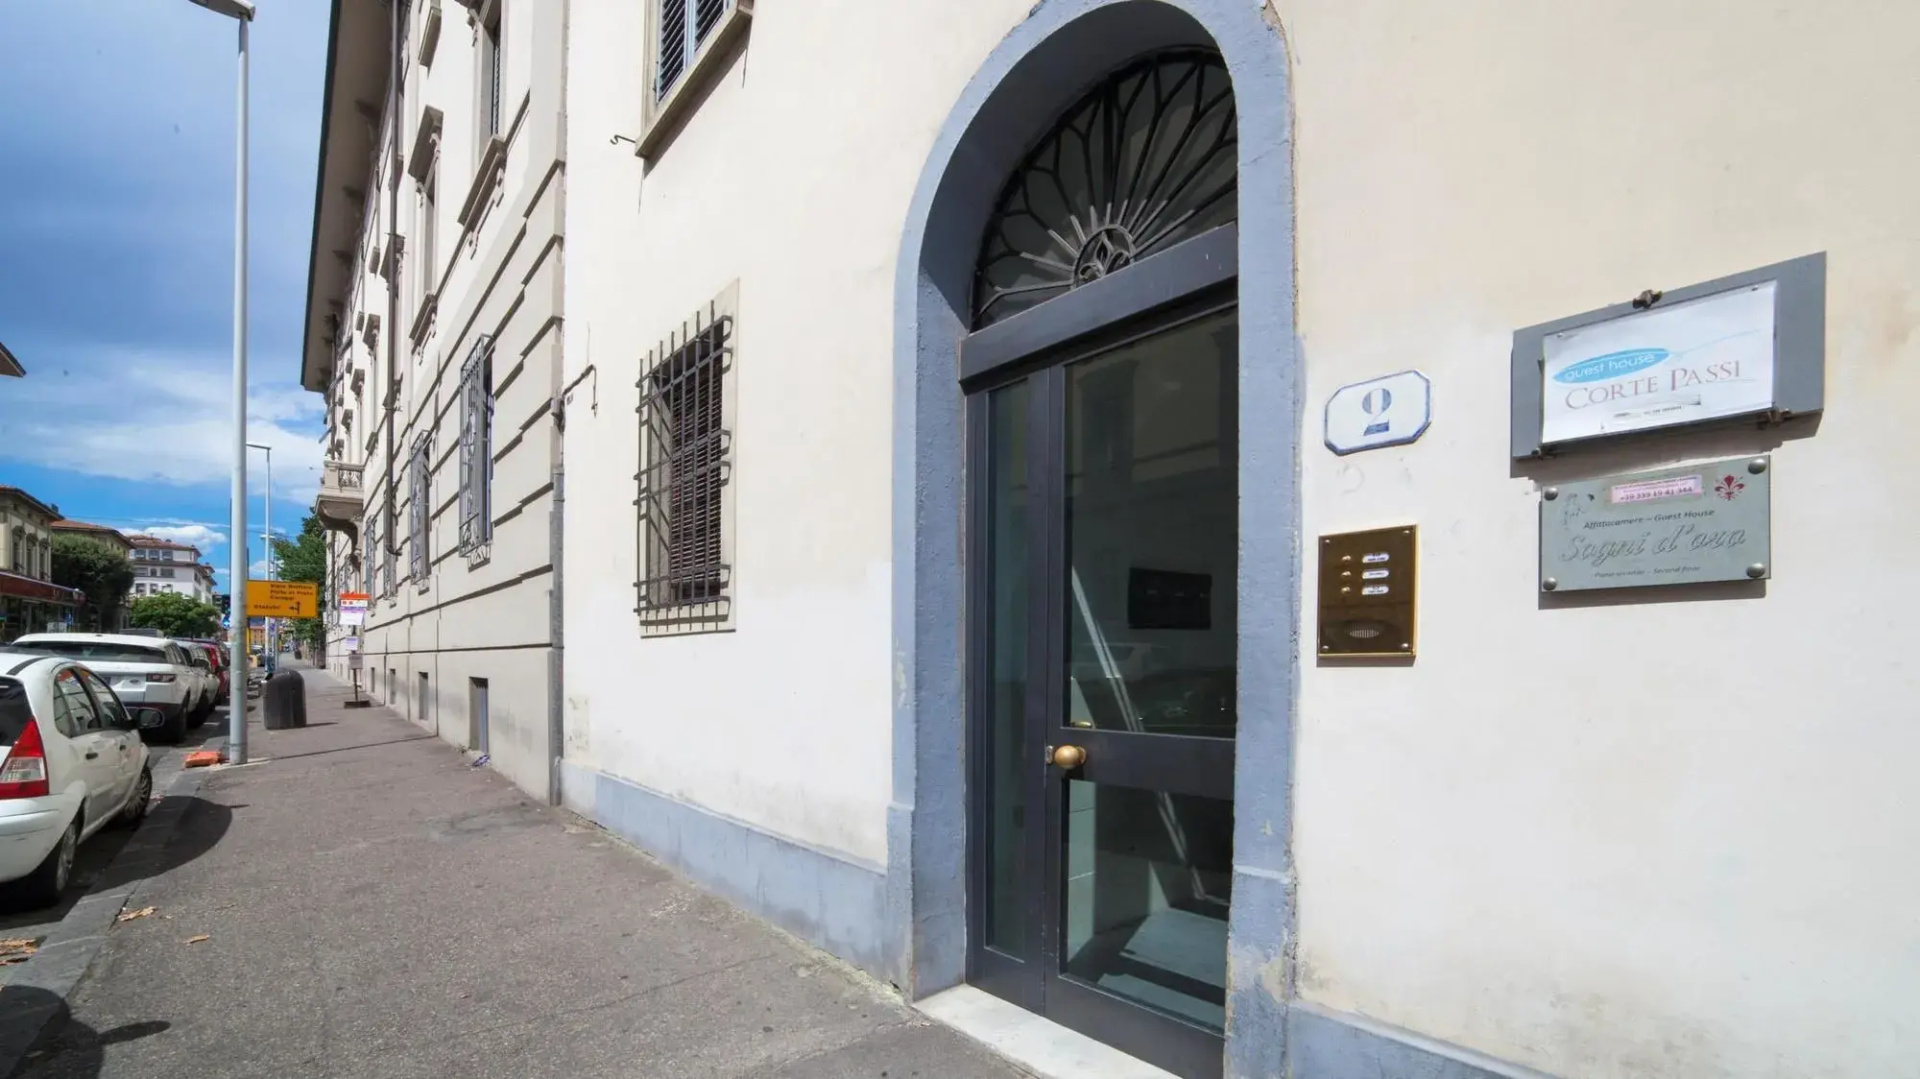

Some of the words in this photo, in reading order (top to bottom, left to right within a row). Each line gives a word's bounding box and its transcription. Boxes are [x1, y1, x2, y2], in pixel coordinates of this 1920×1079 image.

[1608, 352, 1656, 371] house
[1565, 376, 1658, 410] CORTE
[1670, 360, 1740, 392] PASSI
[1361, 387, 1392, 436] 2
[1653, 511, 1683, 522] Guest
[1684, 508, 1716, 519] House
